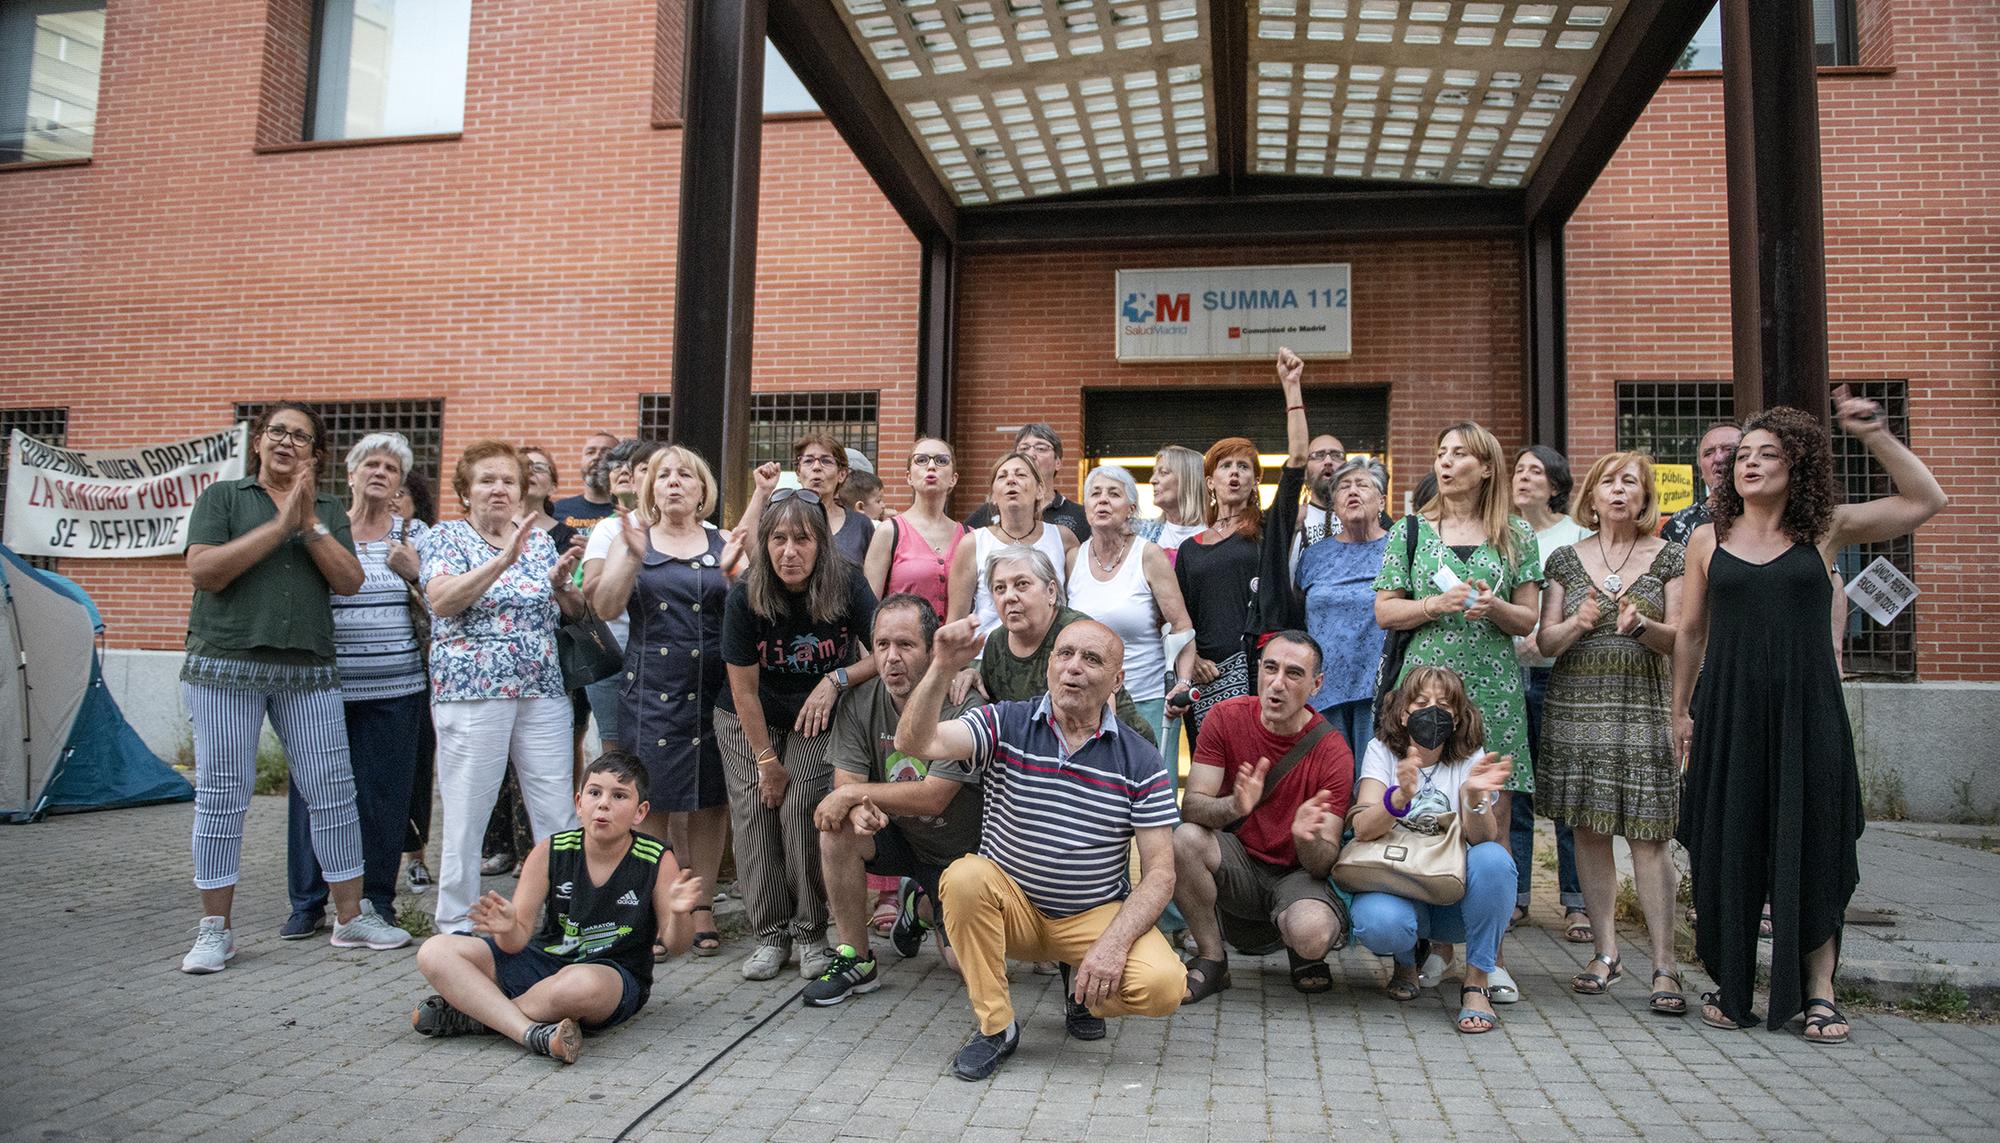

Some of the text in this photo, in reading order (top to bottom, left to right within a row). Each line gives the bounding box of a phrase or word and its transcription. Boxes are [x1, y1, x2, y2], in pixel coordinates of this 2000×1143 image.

[1202, 288, 1347, 311] SUMMA 112
[1242, 326, 1286, 334] Comunidad
[1298, 324, 1327, 332] Madrid
[96, 458, 145, 480] QUIEN
[141, 429, 241, 477] GOBIERNE
[28, 475, 54, 508] LA
[55, 479, 131, 511] SANIDAD
[50, 516, 185, 550] SE DEFIENDE
